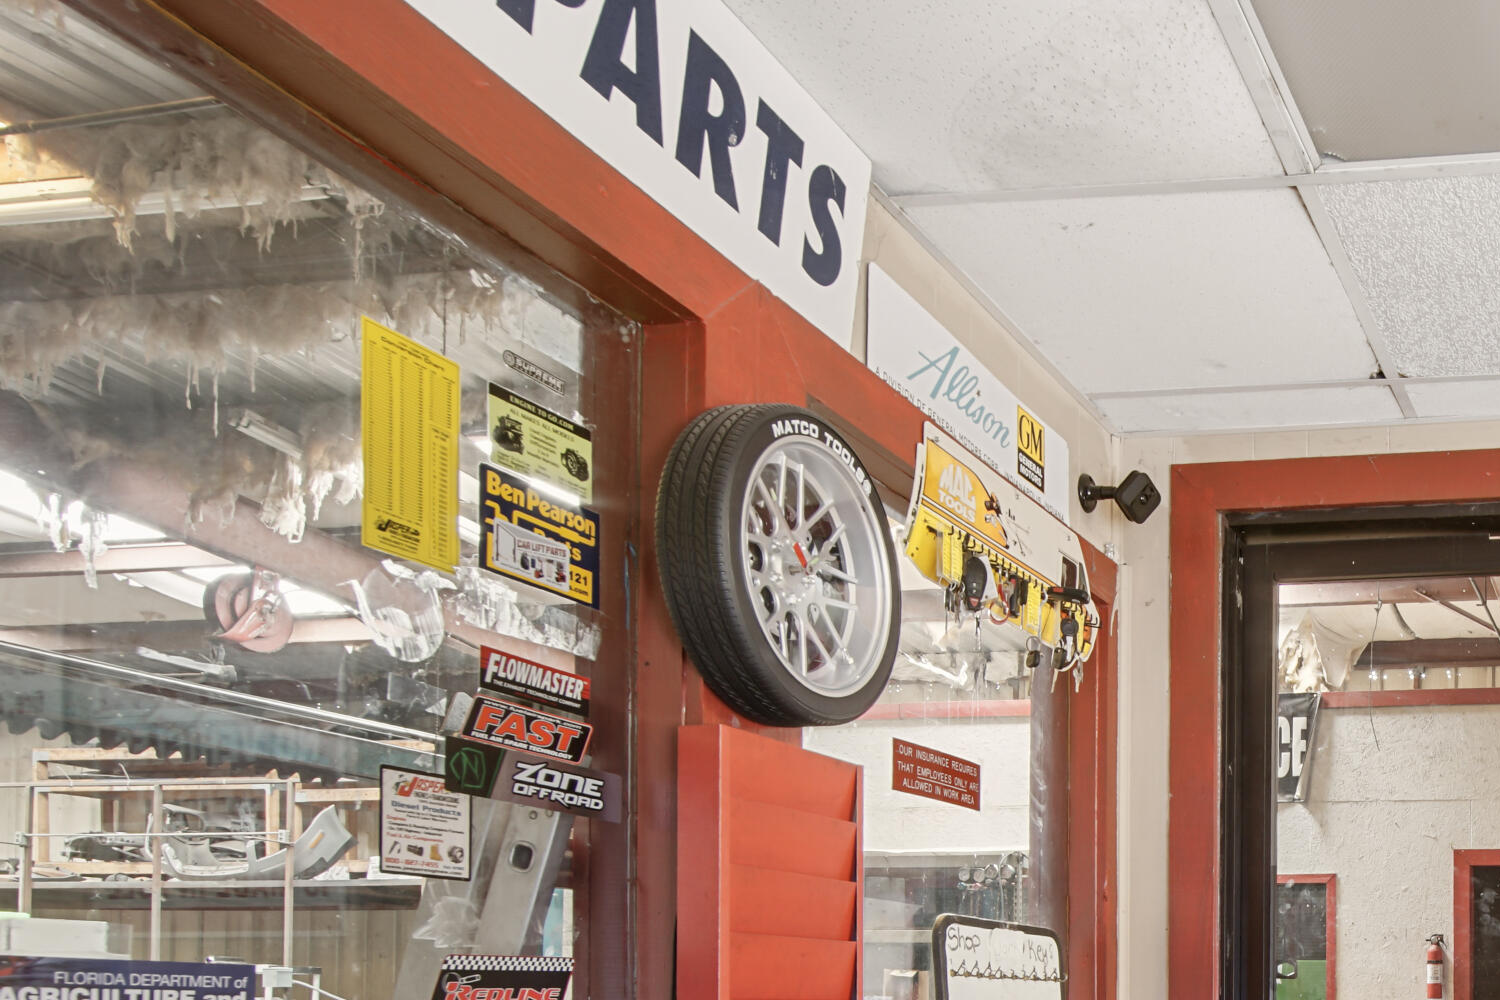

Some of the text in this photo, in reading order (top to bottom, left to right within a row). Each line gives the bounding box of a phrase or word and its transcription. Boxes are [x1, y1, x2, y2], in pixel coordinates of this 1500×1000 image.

[496, 0, 846, 286] ARTS
[907, 346, 1011, 448] Allison
[771, 420, 819, 439] MATCO
[927, 407, 957, 438] GENERAL
[958, 432, 982, 460] MOTORS
[1019, 414, 1043, 462] GM
[1018, 453, 1043, 477] GENERAL
[1019, 463, 1043, 488] MOTORS
[939, 463, 977, 509] MAC
[486, 470, 525, 507] Ben
[527, 487, 596, 537] Pearson
[937, 489, 976, 523] TOOLS
[517, 540, 567, 558] CAR LIFT PARTS
[484, 652, 585, 701] FLOWMASTER
[474, 704, 580, 752] FAST
[471, 731, 574, 760] FUEL AIR SPARK TECHNOLOGY
[898, 744, 977, 777] OUR INSURANCE REQUIRES
[513, 762, 604, 797] ZONE
[897, 760, 979, 792] THAT EMPLOYEES ONLY ARE
[903, 778, 975, 804] ALLOWED IN WORK AREA
[391, 801, 462, 816] Diesel Products
[512, 783, 604, 811] OFFROAD
[948, 927, 980, 952] Shop
[54, 971, 248, 989] FLORIDA DEPARTMENT of
